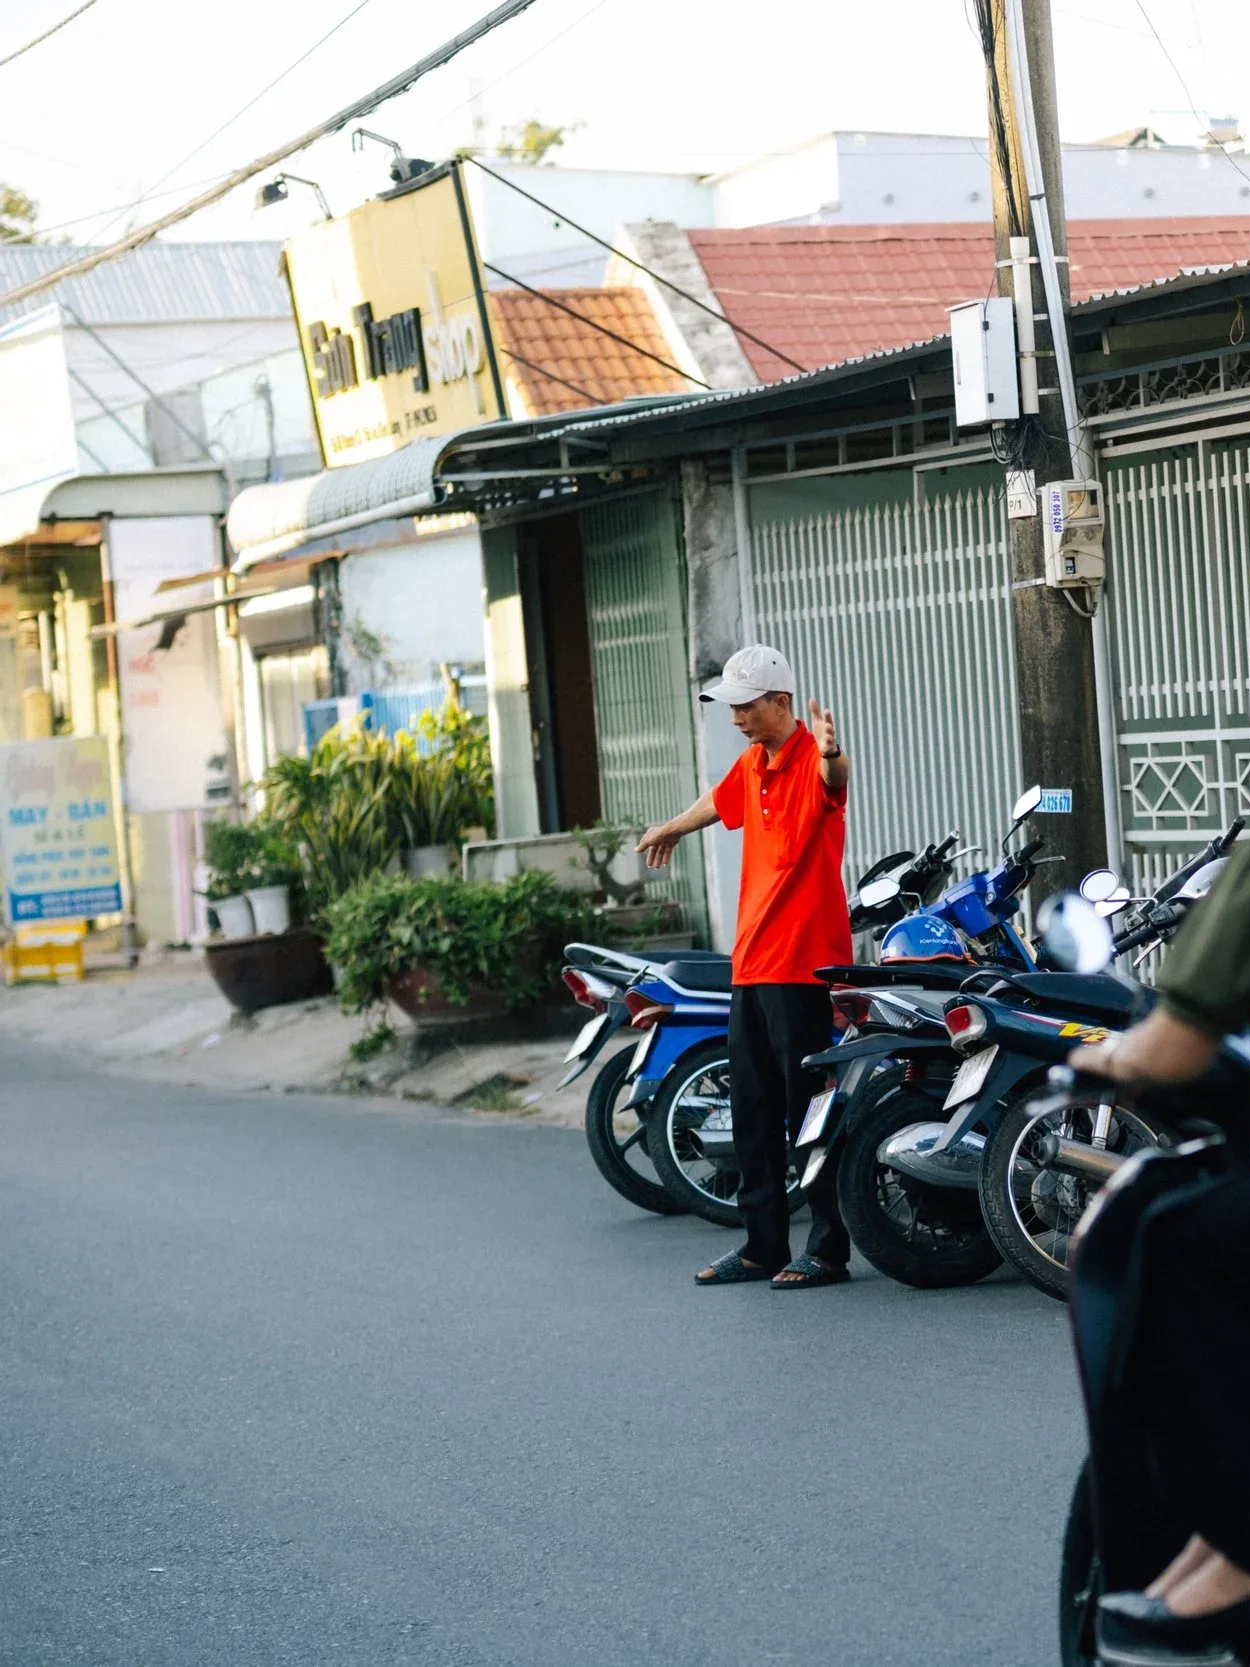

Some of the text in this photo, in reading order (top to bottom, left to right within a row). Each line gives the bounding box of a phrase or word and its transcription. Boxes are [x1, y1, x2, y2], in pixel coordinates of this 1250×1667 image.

[352, 301, 429, 394] Trang
[1053, 517, 1063, 533] 0972
[9, 806, 47, 825] MAY
